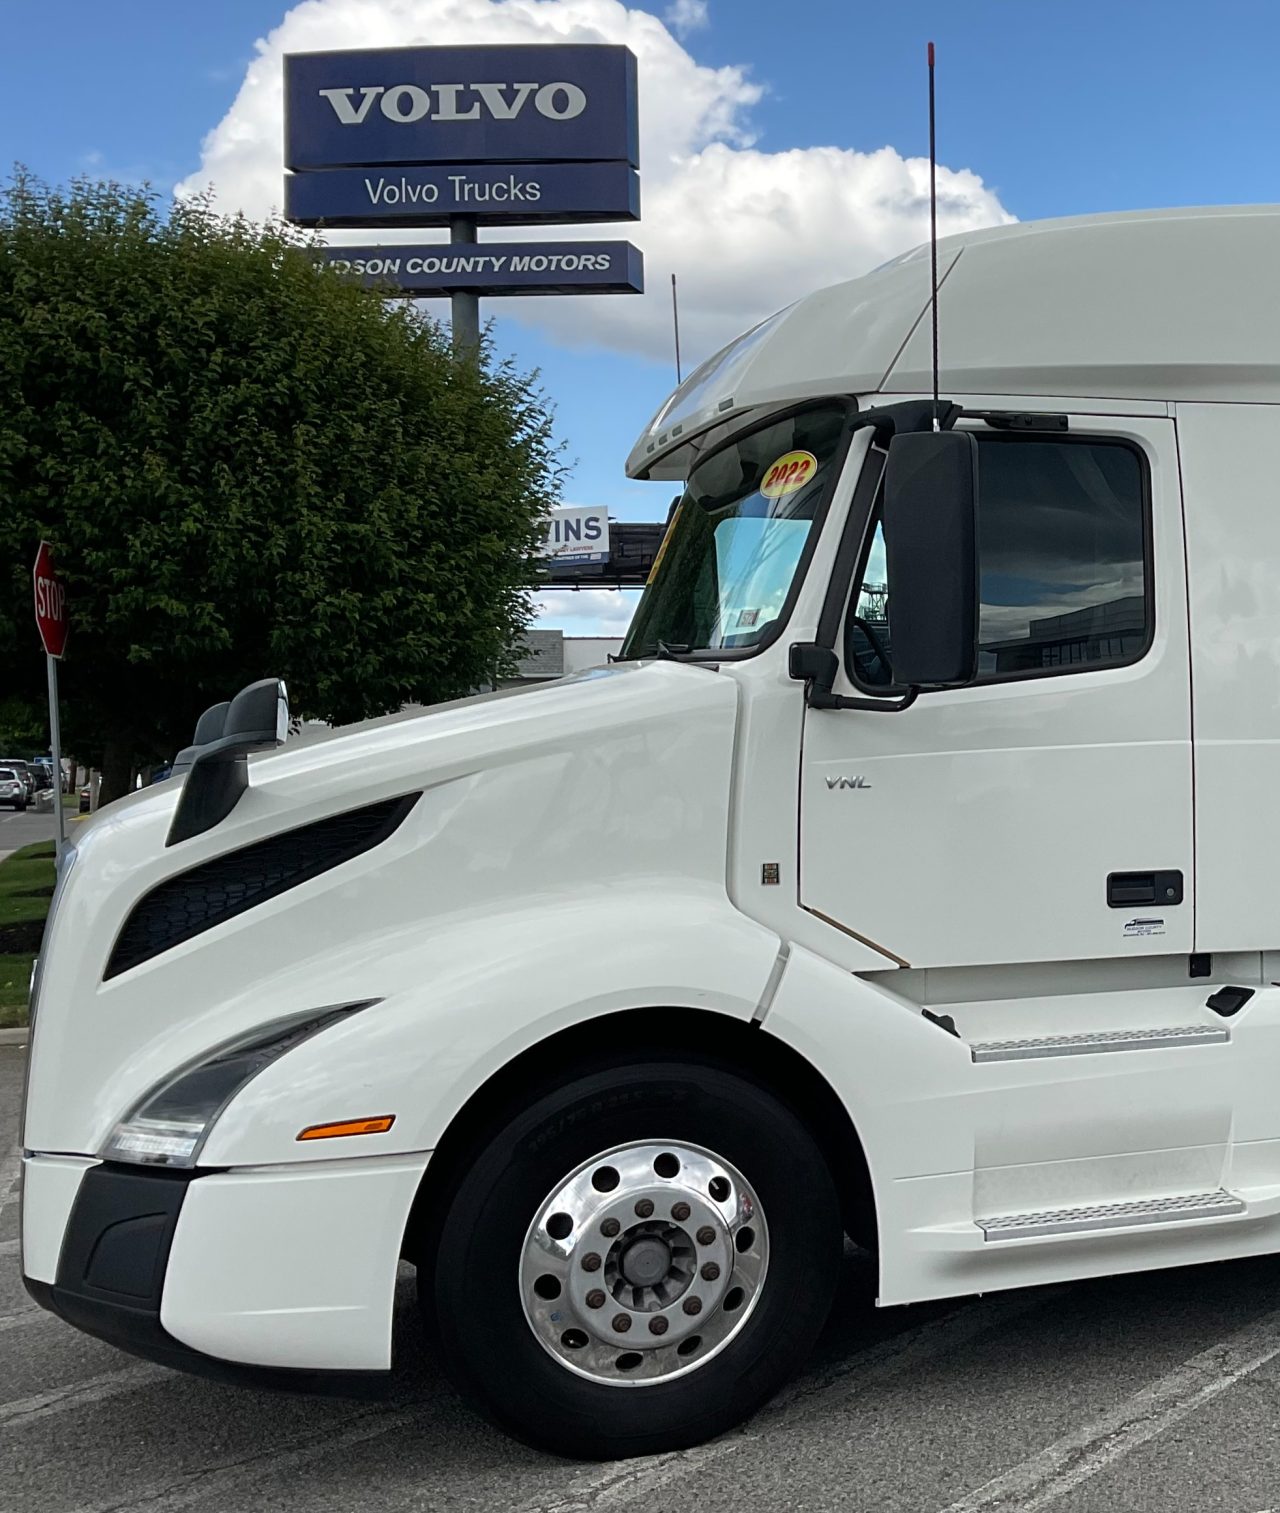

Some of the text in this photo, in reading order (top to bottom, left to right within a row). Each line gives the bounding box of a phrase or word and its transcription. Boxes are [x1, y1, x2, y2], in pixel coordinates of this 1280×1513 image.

[318, 81, 587, 125] VOLVO
[364, 174, 542, 205] Volvo Trucks
[405, 255, 507, 274] COUNTY
[510, 253, 611, 272] MOTORS
[764, 459, 811, 489] 2022
[541, 516, 602, 543] INS
[37, 576, 66, 622] STOP
[825, 776, 872, 790] VNL
